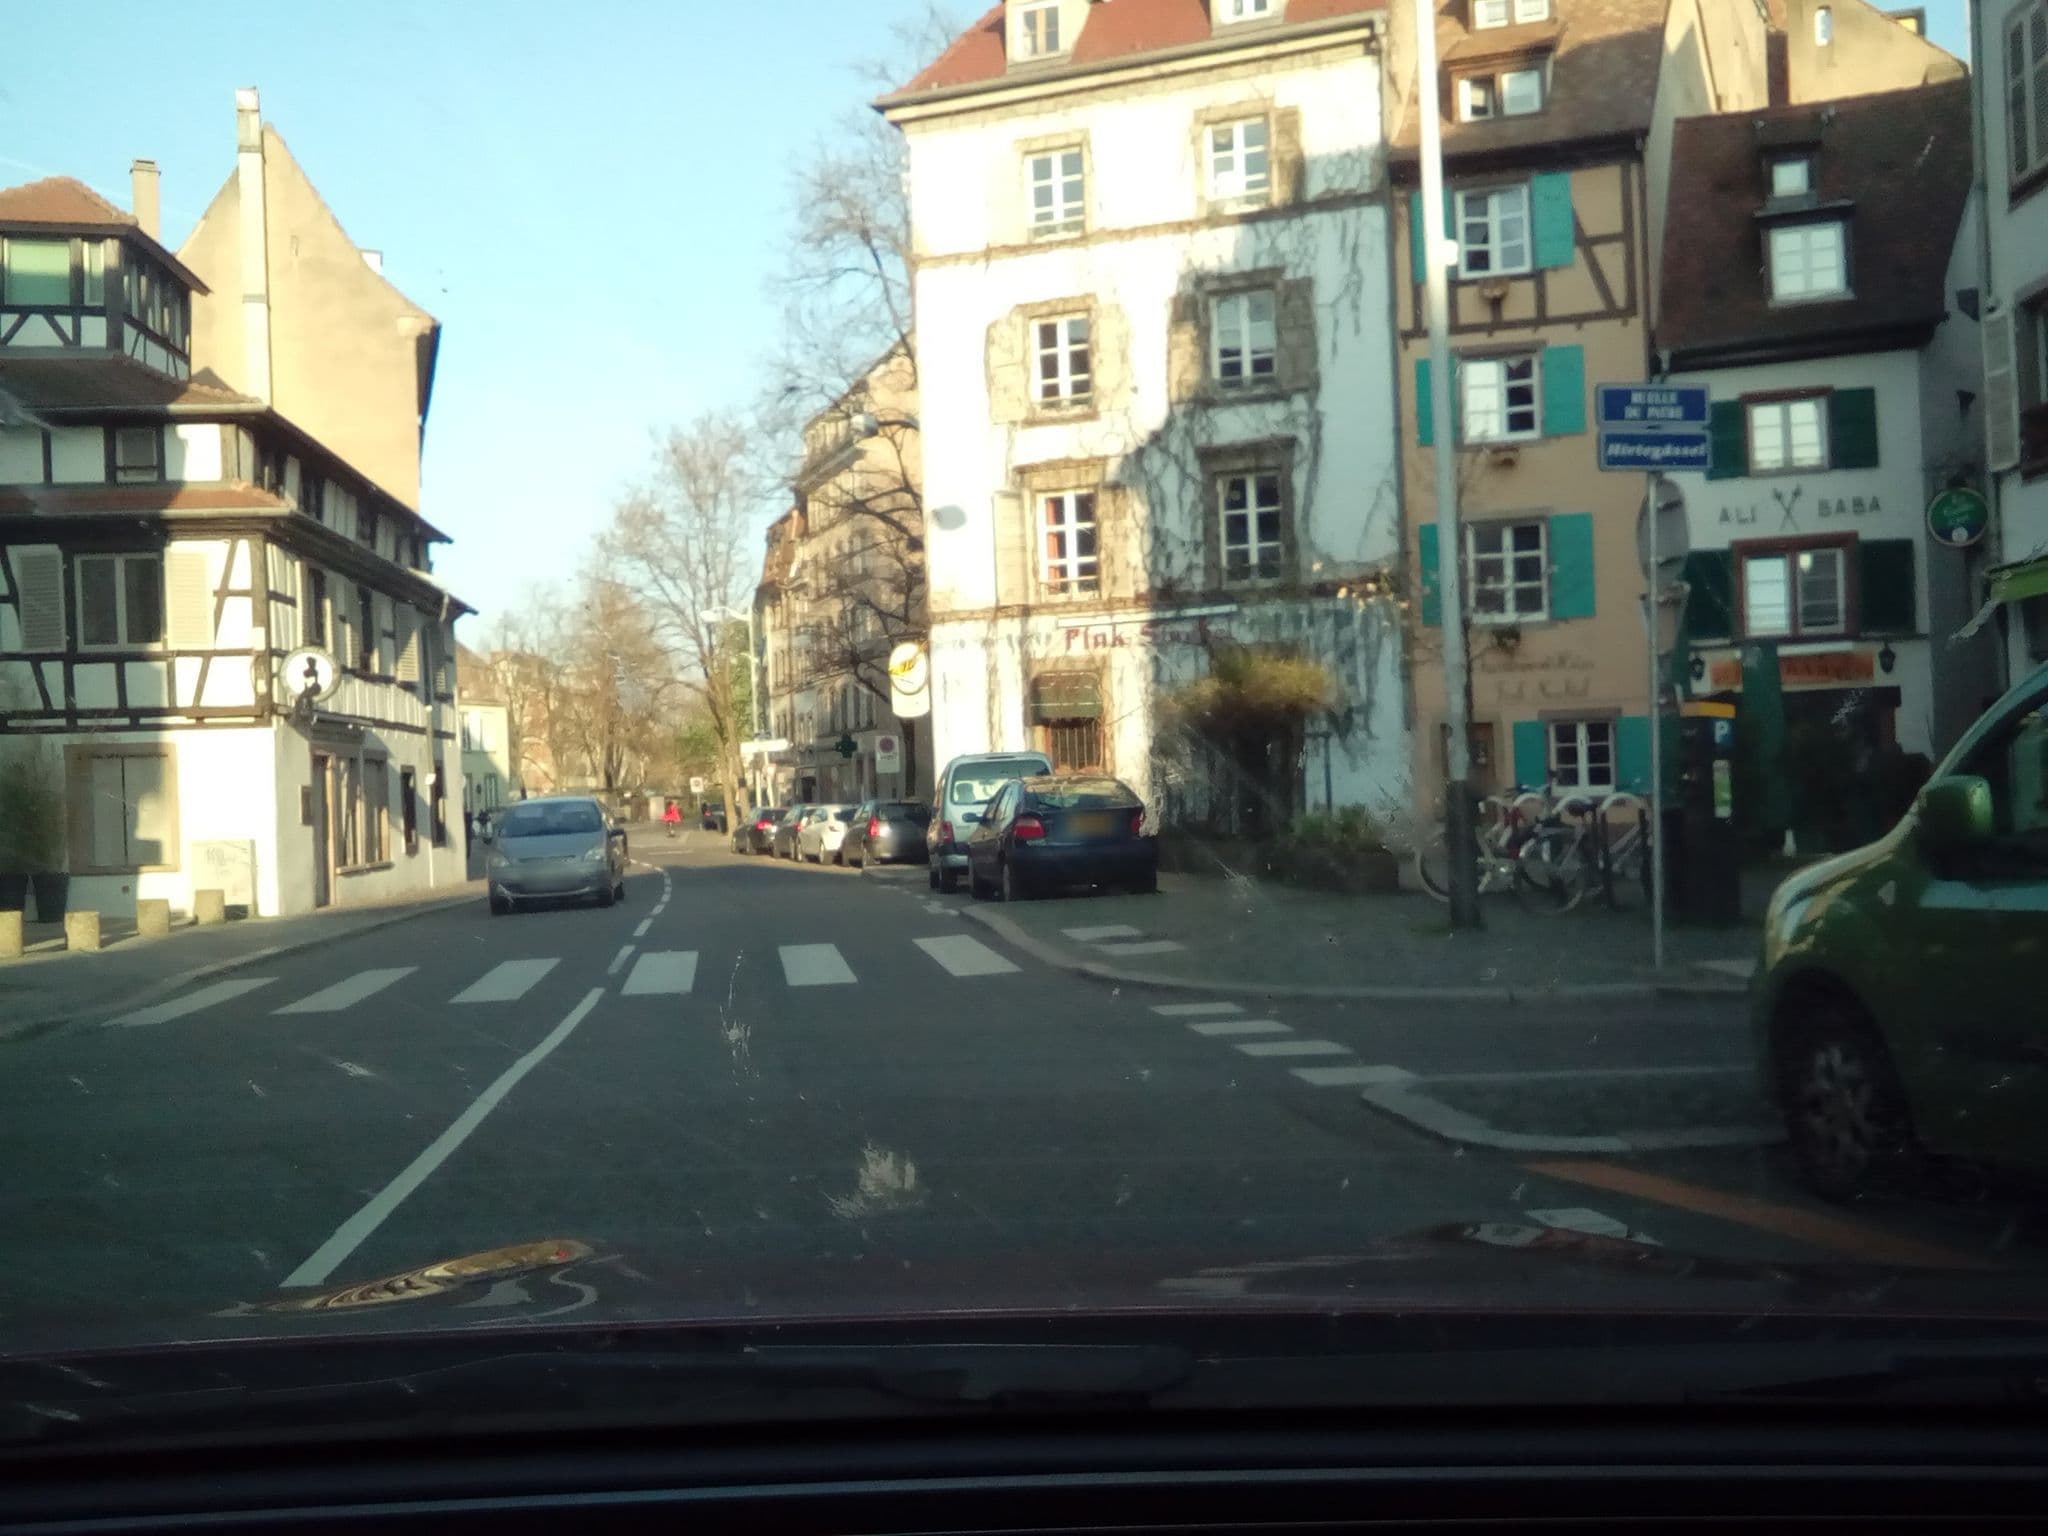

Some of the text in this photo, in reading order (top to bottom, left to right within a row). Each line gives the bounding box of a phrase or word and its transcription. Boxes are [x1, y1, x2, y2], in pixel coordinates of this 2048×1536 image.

[1719, 495, 1881, 524] ALI BABA
[1714, 720, 1730, 743] P
